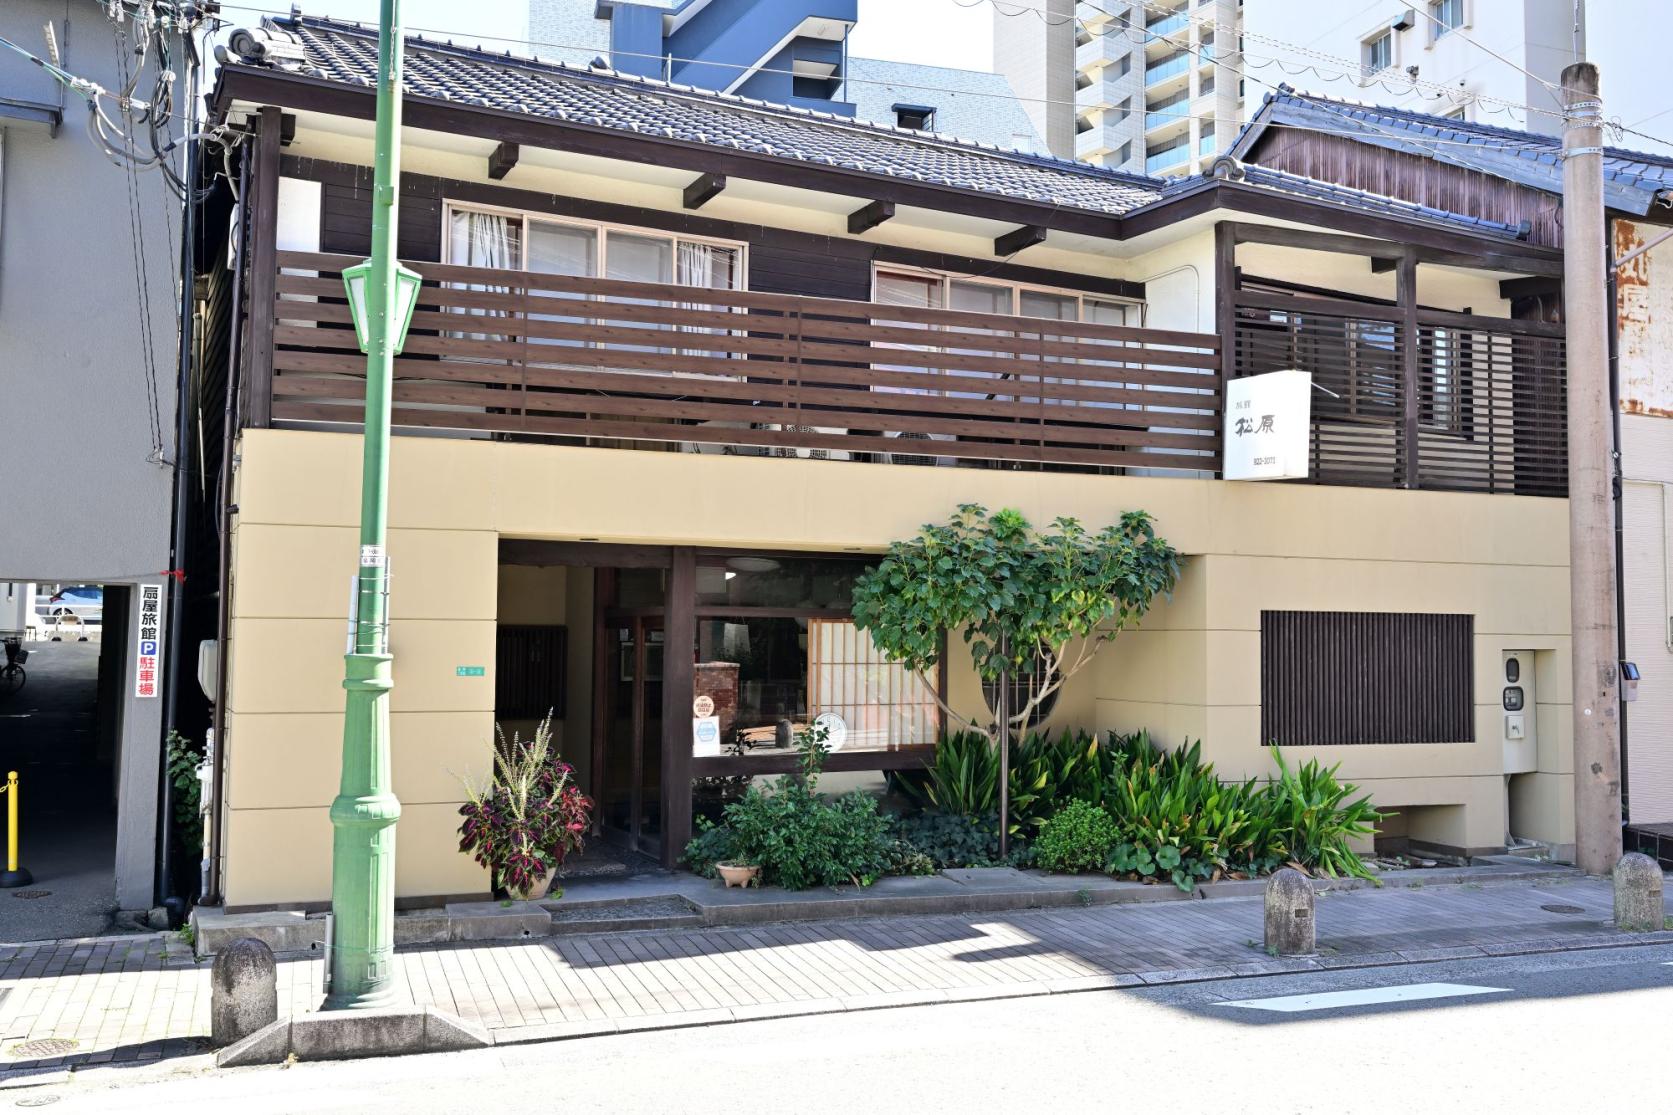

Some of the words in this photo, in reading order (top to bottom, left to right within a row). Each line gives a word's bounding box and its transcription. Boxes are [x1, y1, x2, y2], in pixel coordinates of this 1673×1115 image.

[1235, 414, 1276, 437] 松原
[141, 587, 158, 640] 扇屋旅館
[139, 657, 155, 695] 駐車場
